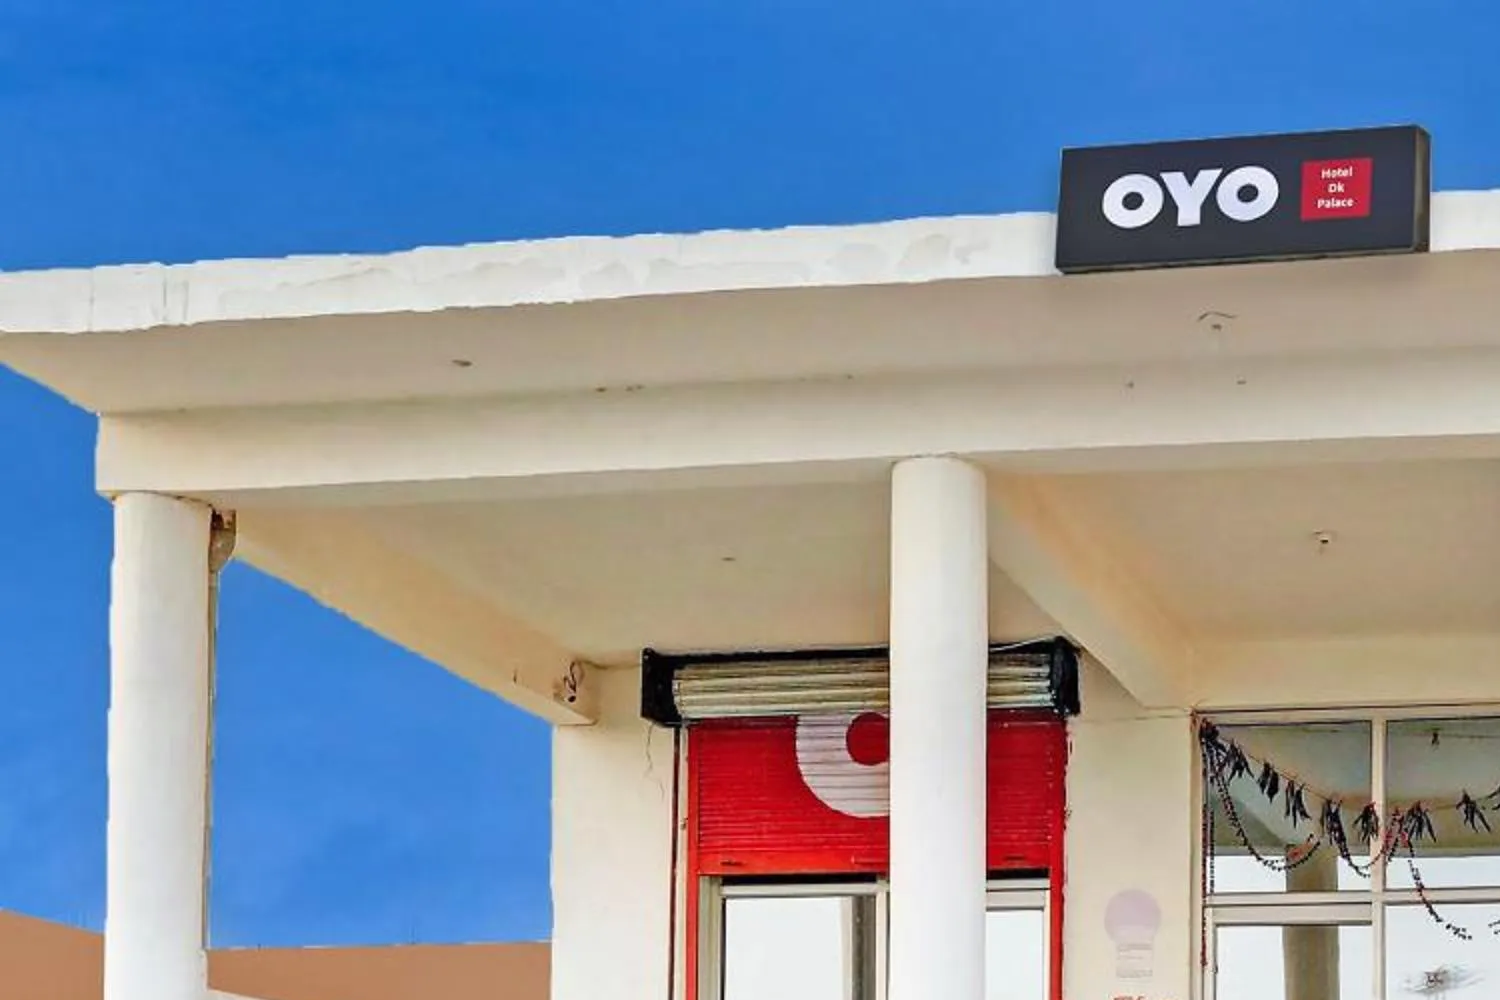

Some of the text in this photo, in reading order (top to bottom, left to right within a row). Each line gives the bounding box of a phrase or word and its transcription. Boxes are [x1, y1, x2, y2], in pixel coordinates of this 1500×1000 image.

[1321, 166, 1353, 179] Hotel
[1328, 181, 1345, 193] Dk
[1102, 165, 1279, 229] OYO
[1317, 197, 1354, 209] Palace
